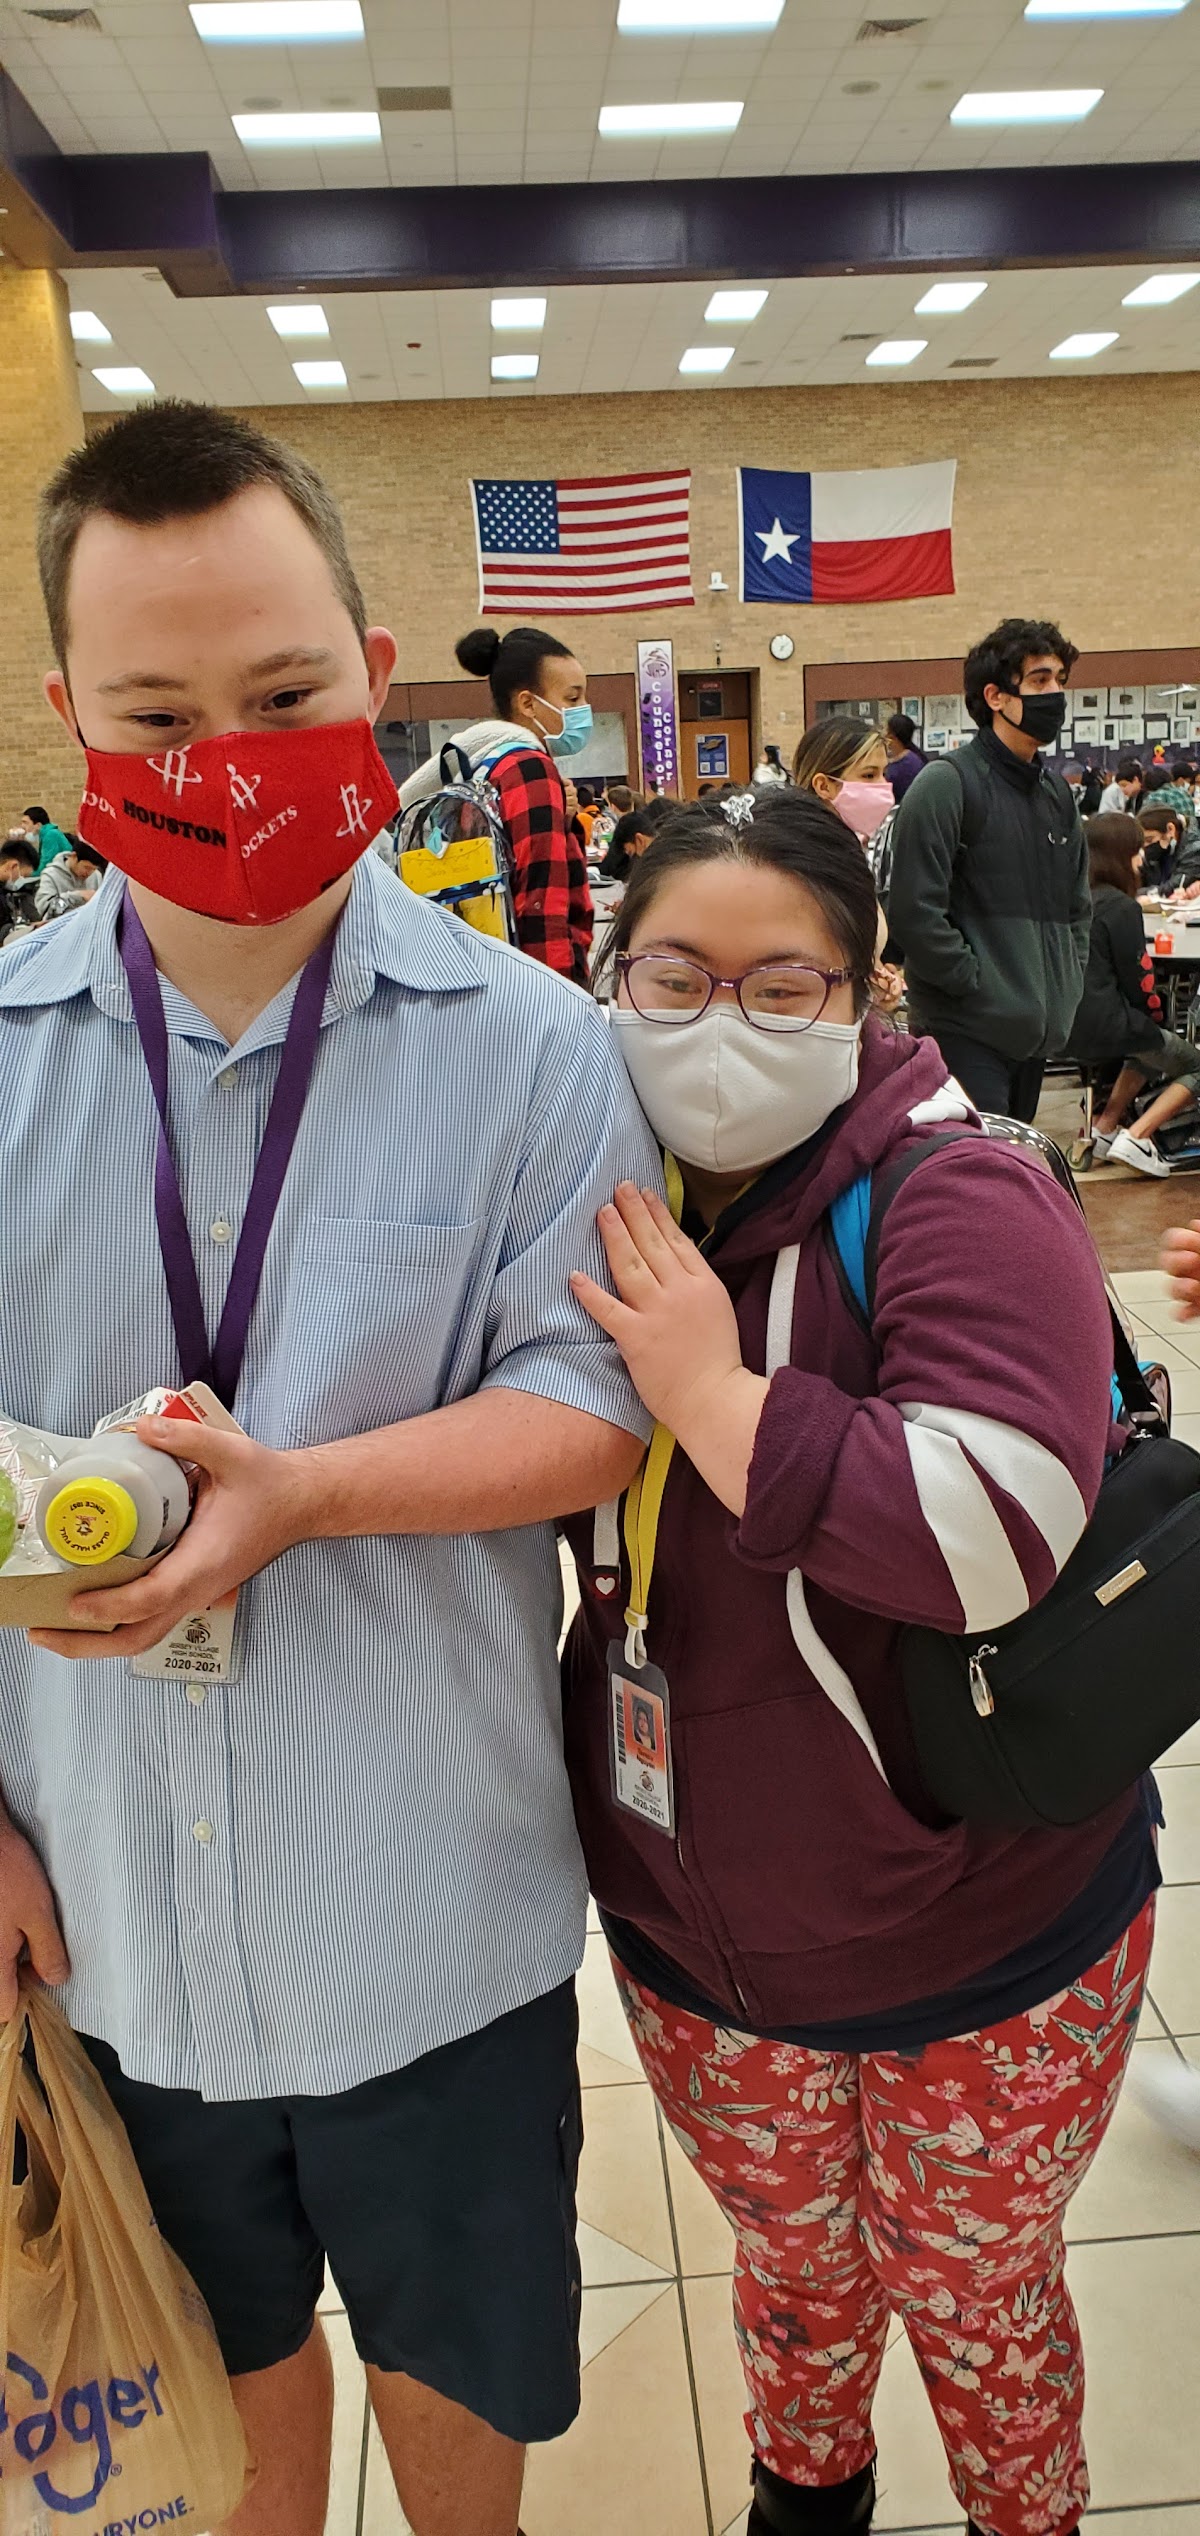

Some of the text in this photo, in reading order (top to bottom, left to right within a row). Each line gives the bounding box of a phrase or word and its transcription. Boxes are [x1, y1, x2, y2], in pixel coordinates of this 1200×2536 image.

[651, 681, 665, 796] Counselors
[663, 712, 674, 782] Corner
[122, 797, 227, 849] HOUSTON
[241, 805, 298, 859] OCKETS
[183, 1391, 208, 1418] APPLE JUICE
[85, 1501, 106, 1515] SINCE
[59, 1527, 110, 1552] GLASS HALF FULL
[164, 1657, 221, 1673] 2020-2021
[632, 1795, 665, 1821] 2020-2021
[0, 2351, 164, 2515] oger
